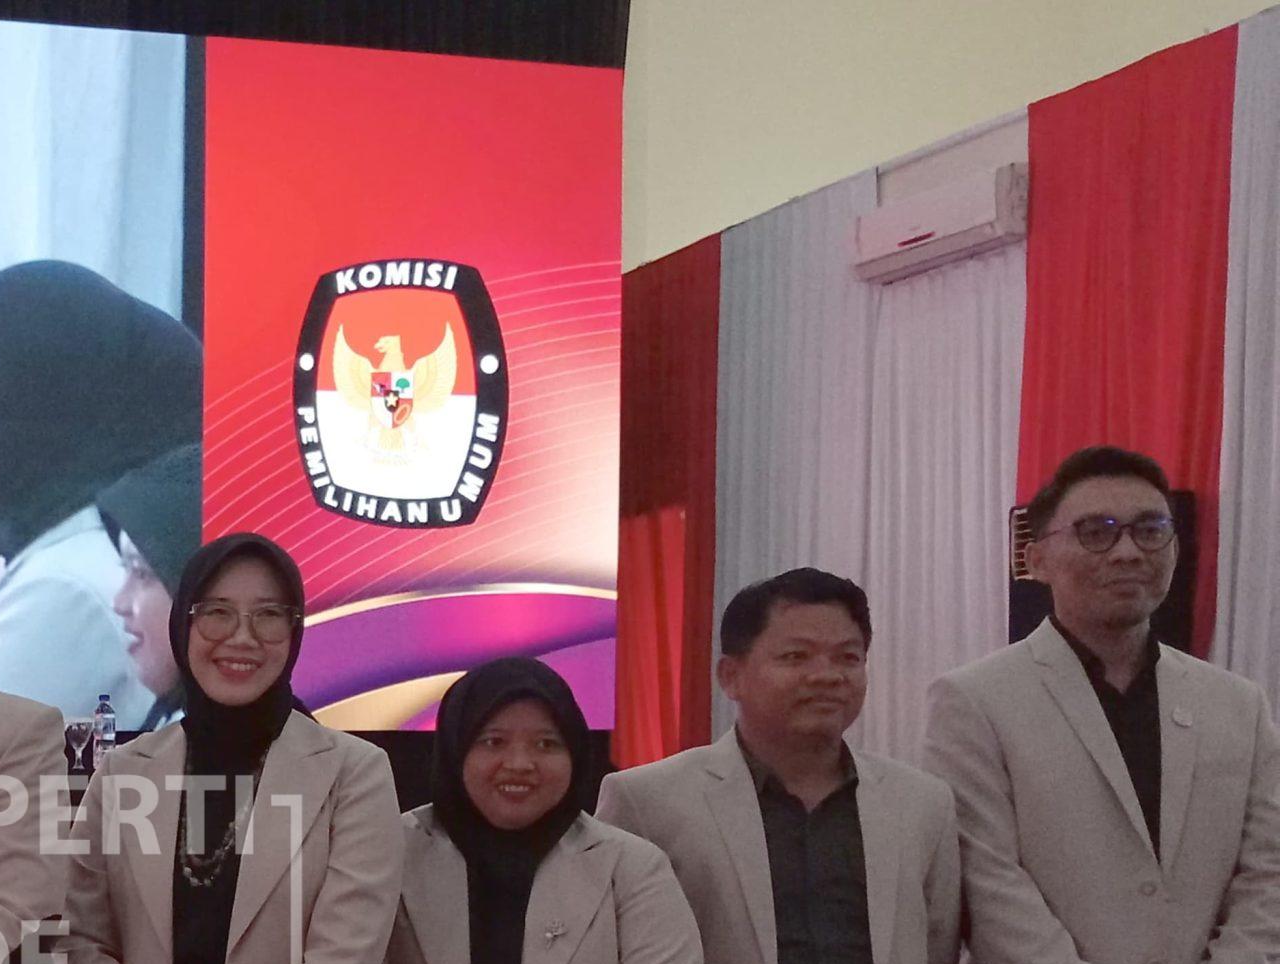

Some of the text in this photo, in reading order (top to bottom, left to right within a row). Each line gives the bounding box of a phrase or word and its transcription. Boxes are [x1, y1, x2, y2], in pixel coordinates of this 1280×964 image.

[335, 261, 459, 295] KOMISI
[297, 405, 501, 524] PEMILIHAN UMUM
